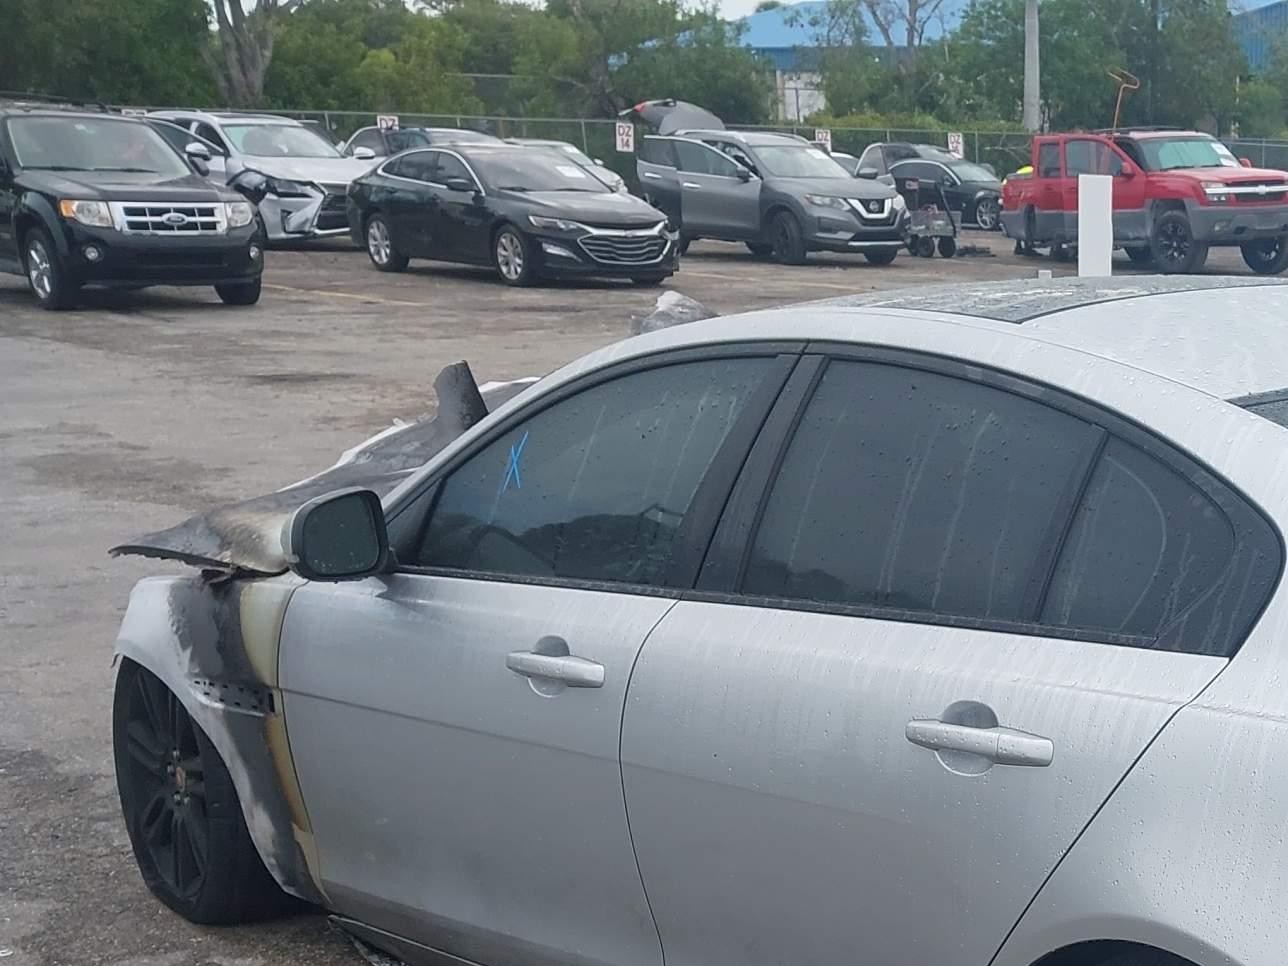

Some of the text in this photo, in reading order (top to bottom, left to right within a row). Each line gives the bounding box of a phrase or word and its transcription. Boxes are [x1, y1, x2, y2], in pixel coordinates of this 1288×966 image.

[618, 125, 632, 137] DZ
[817, 130, 830, 142] DZ
[621, 138, 630, 149] 14
[949, 134, 961, 145] DZ
